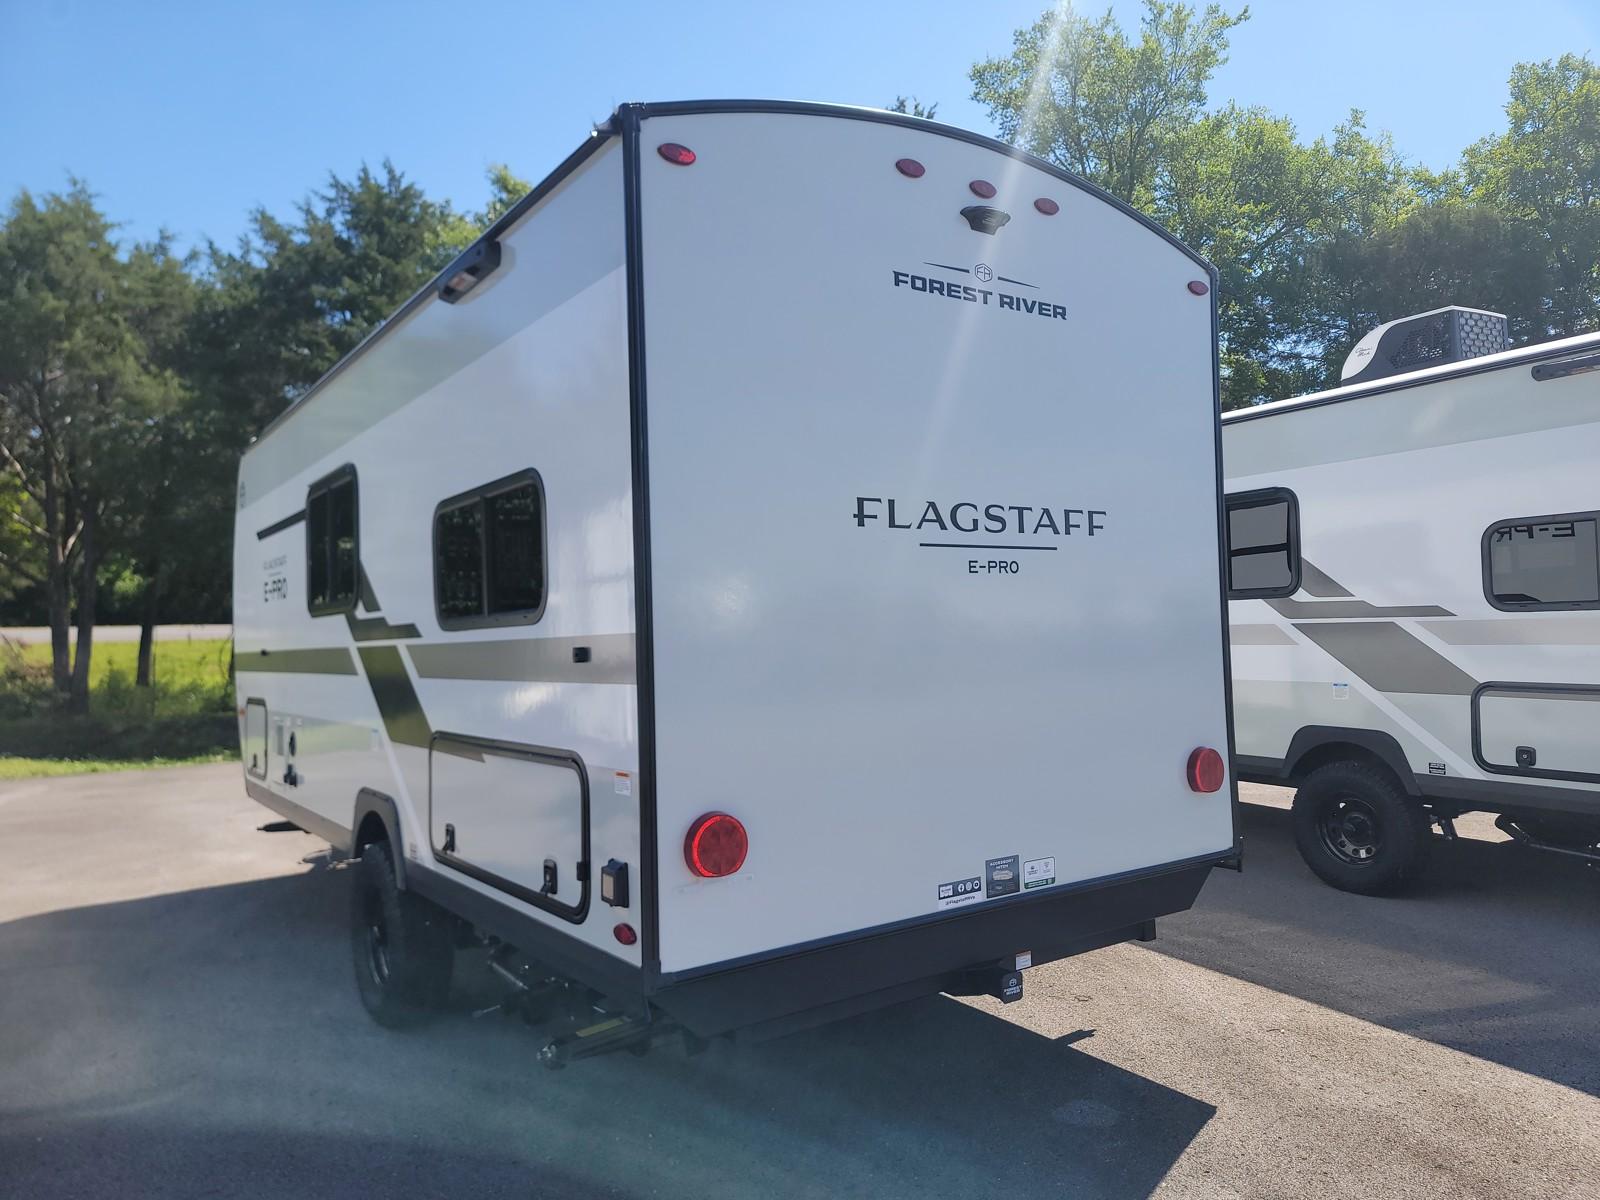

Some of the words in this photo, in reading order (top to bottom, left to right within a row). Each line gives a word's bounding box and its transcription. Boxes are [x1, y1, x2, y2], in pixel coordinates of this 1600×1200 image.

[893, 270, 993, 305] FOREST
[998, 293, 1067, 321] RIVER
[853, 496, 1107, 537] FLAGSTAFF
[968, 560, 1020, 574] E-PRO
[264, 577, 288, 603] E-PRO
